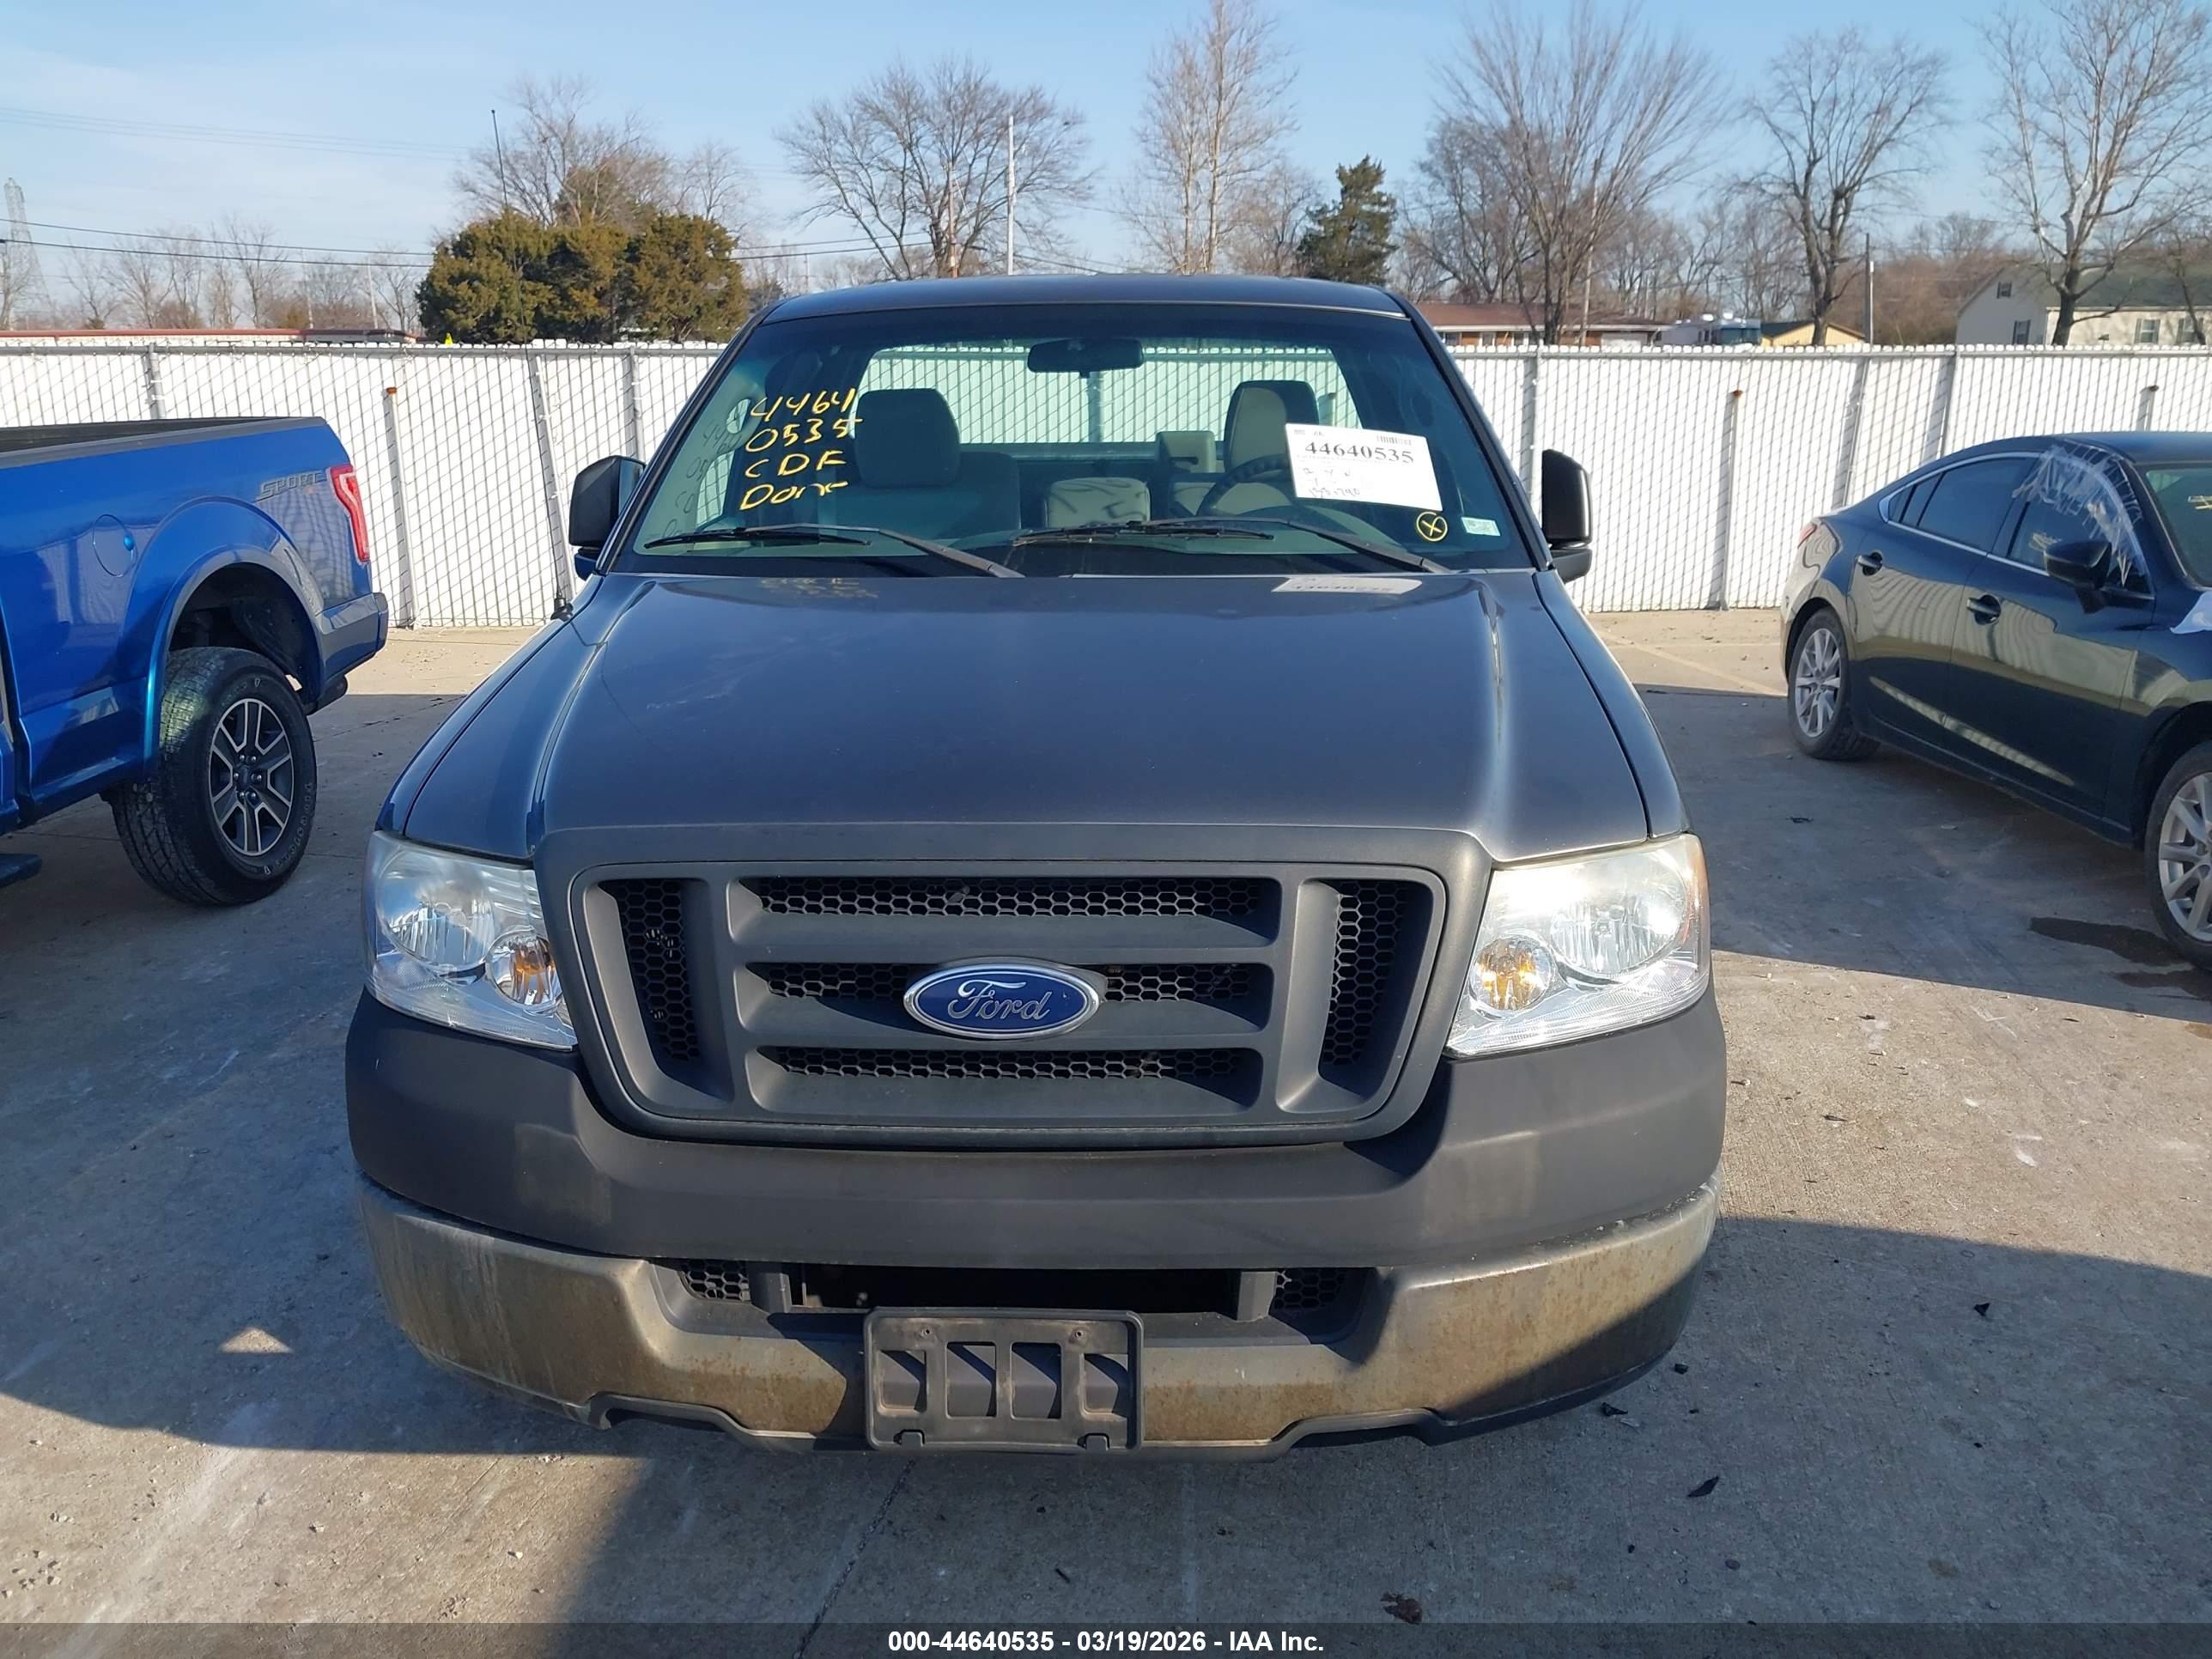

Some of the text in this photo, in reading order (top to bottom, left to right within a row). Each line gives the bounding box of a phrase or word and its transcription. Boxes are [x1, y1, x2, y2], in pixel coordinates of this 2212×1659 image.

[750, 388, 856, 422] 4464
[1305, 441, 1414, 464] 44640535
[257, 471, 326, 501] SPORT
[947, 979, 1050, 1020] Ford
